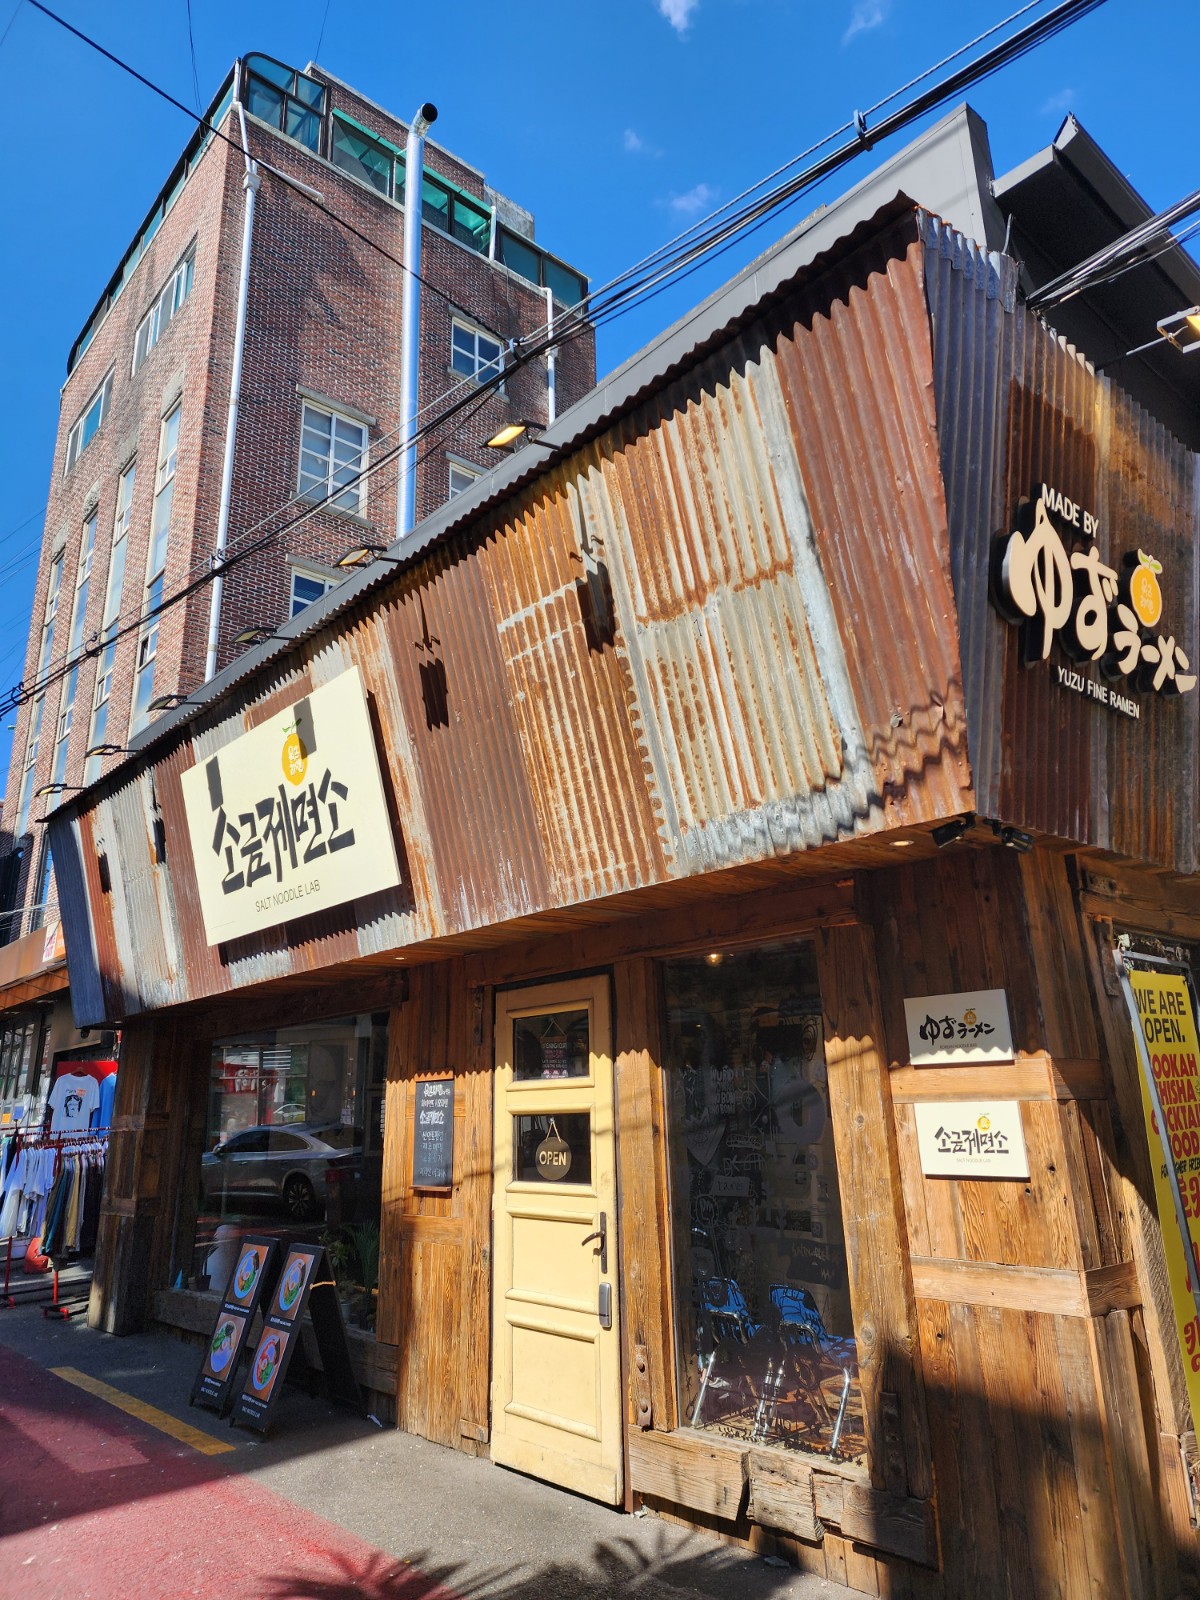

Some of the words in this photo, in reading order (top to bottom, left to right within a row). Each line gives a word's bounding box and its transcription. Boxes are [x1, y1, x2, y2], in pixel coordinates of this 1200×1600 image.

[1042, 483, 1080, 528] MADE
[1083, 509, 1100, 538] BY
[1057, 665, 1085, 692] YUZU
[1087, 680, 1108, 704] FINE
[1110, 690, 1140, 719] RAMEN
[212, 768, 355, 895] 소금제면소
[255, 896, 272, 913] SALT
[273, 885, 303, 907] NOODLE
[305, 879, 321, 896] LAB
[1134, 988, 1157, 1014] WE
[1159, 991, 1187, 1016] ARE
[919, 1014, 995, 1045] ゆずラーメン
[1144, 1018, 1186, 1043] OPEN.
[1152, 1053, 1198, 1079] OOKAH
[1156, 1079, 1197, 1105] HISHA
[934, 1126, 1009, 1155] 소금제면소
[1167, 1130, 1199, 1159] OOD
[539, 1151, 567, 1166] OPEN
